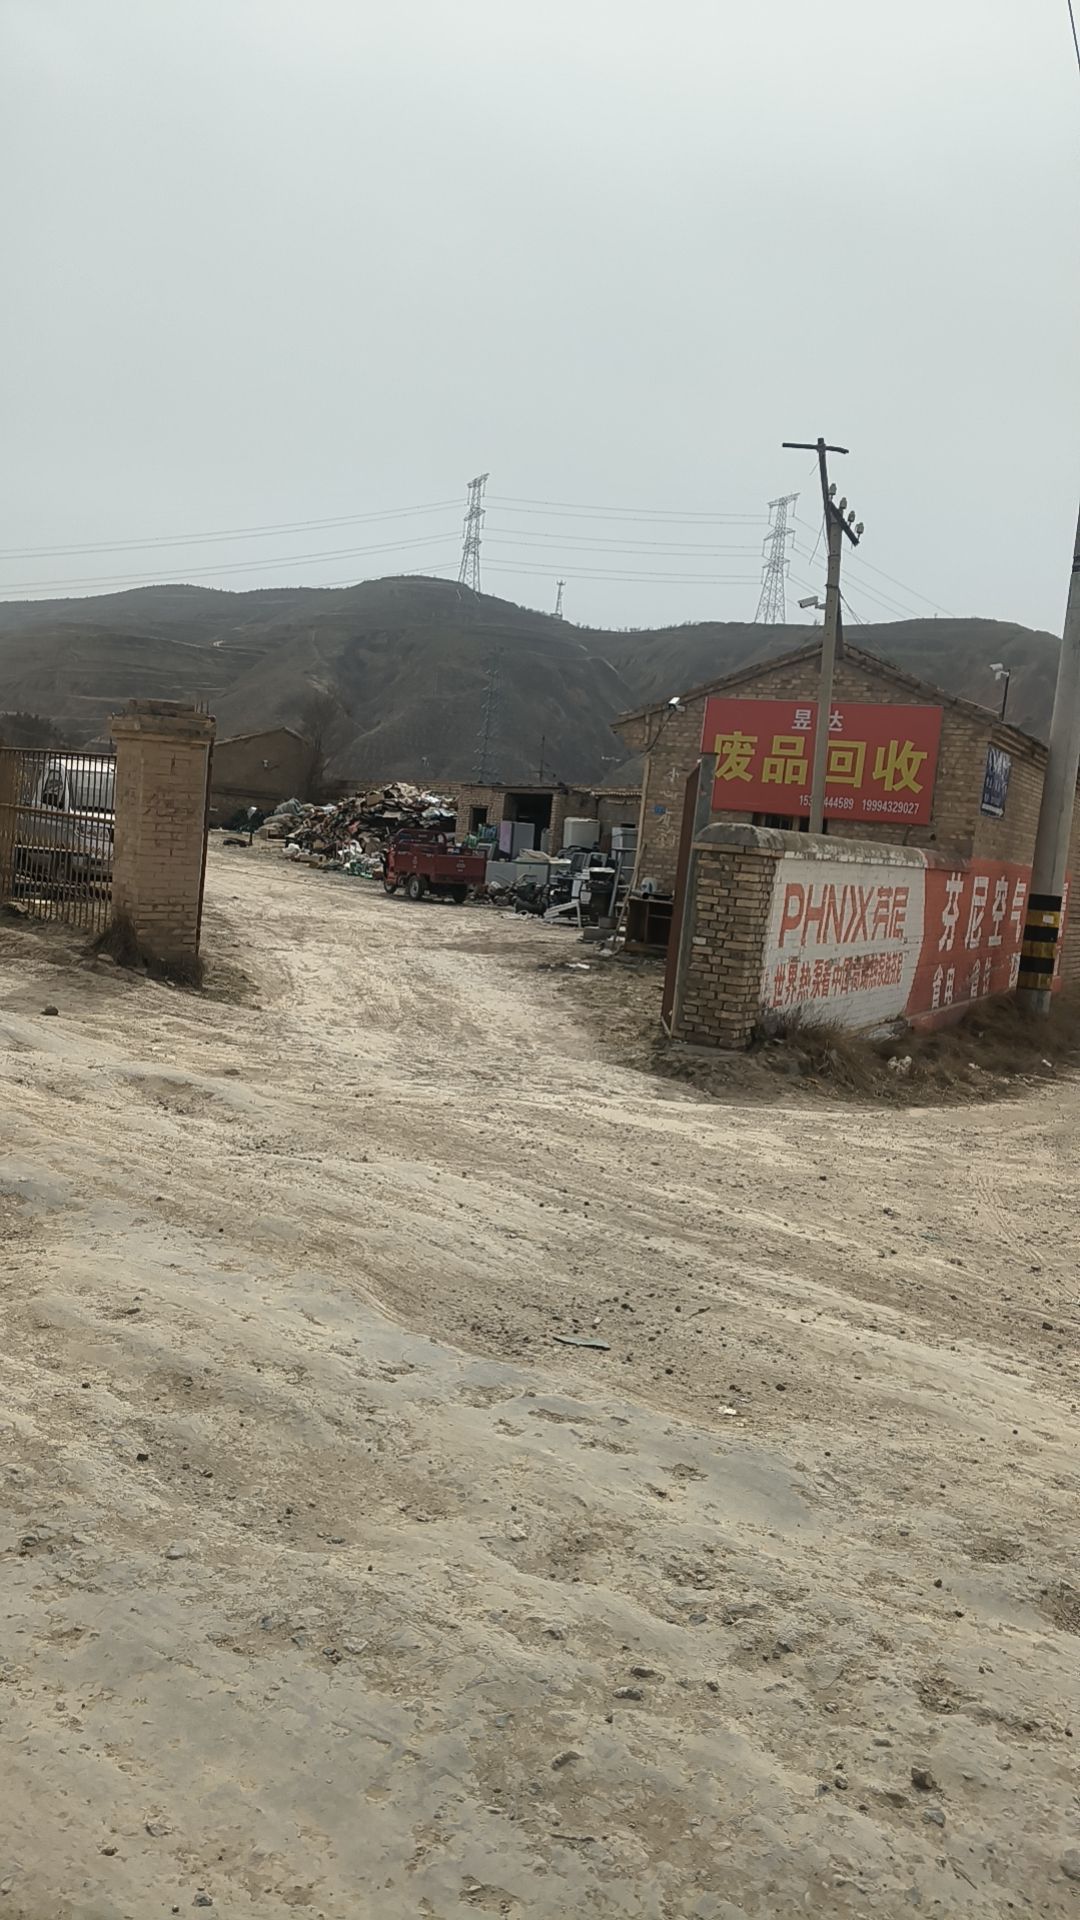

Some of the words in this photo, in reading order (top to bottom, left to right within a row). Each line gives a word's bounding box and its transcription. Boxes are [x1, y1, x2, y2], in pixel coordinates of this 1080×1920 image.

[713, 730, 929, 795] 废品回收
[861, 799, 920, 815] 19994329027
[938, 871, 1069, 952] 芬尼空气
